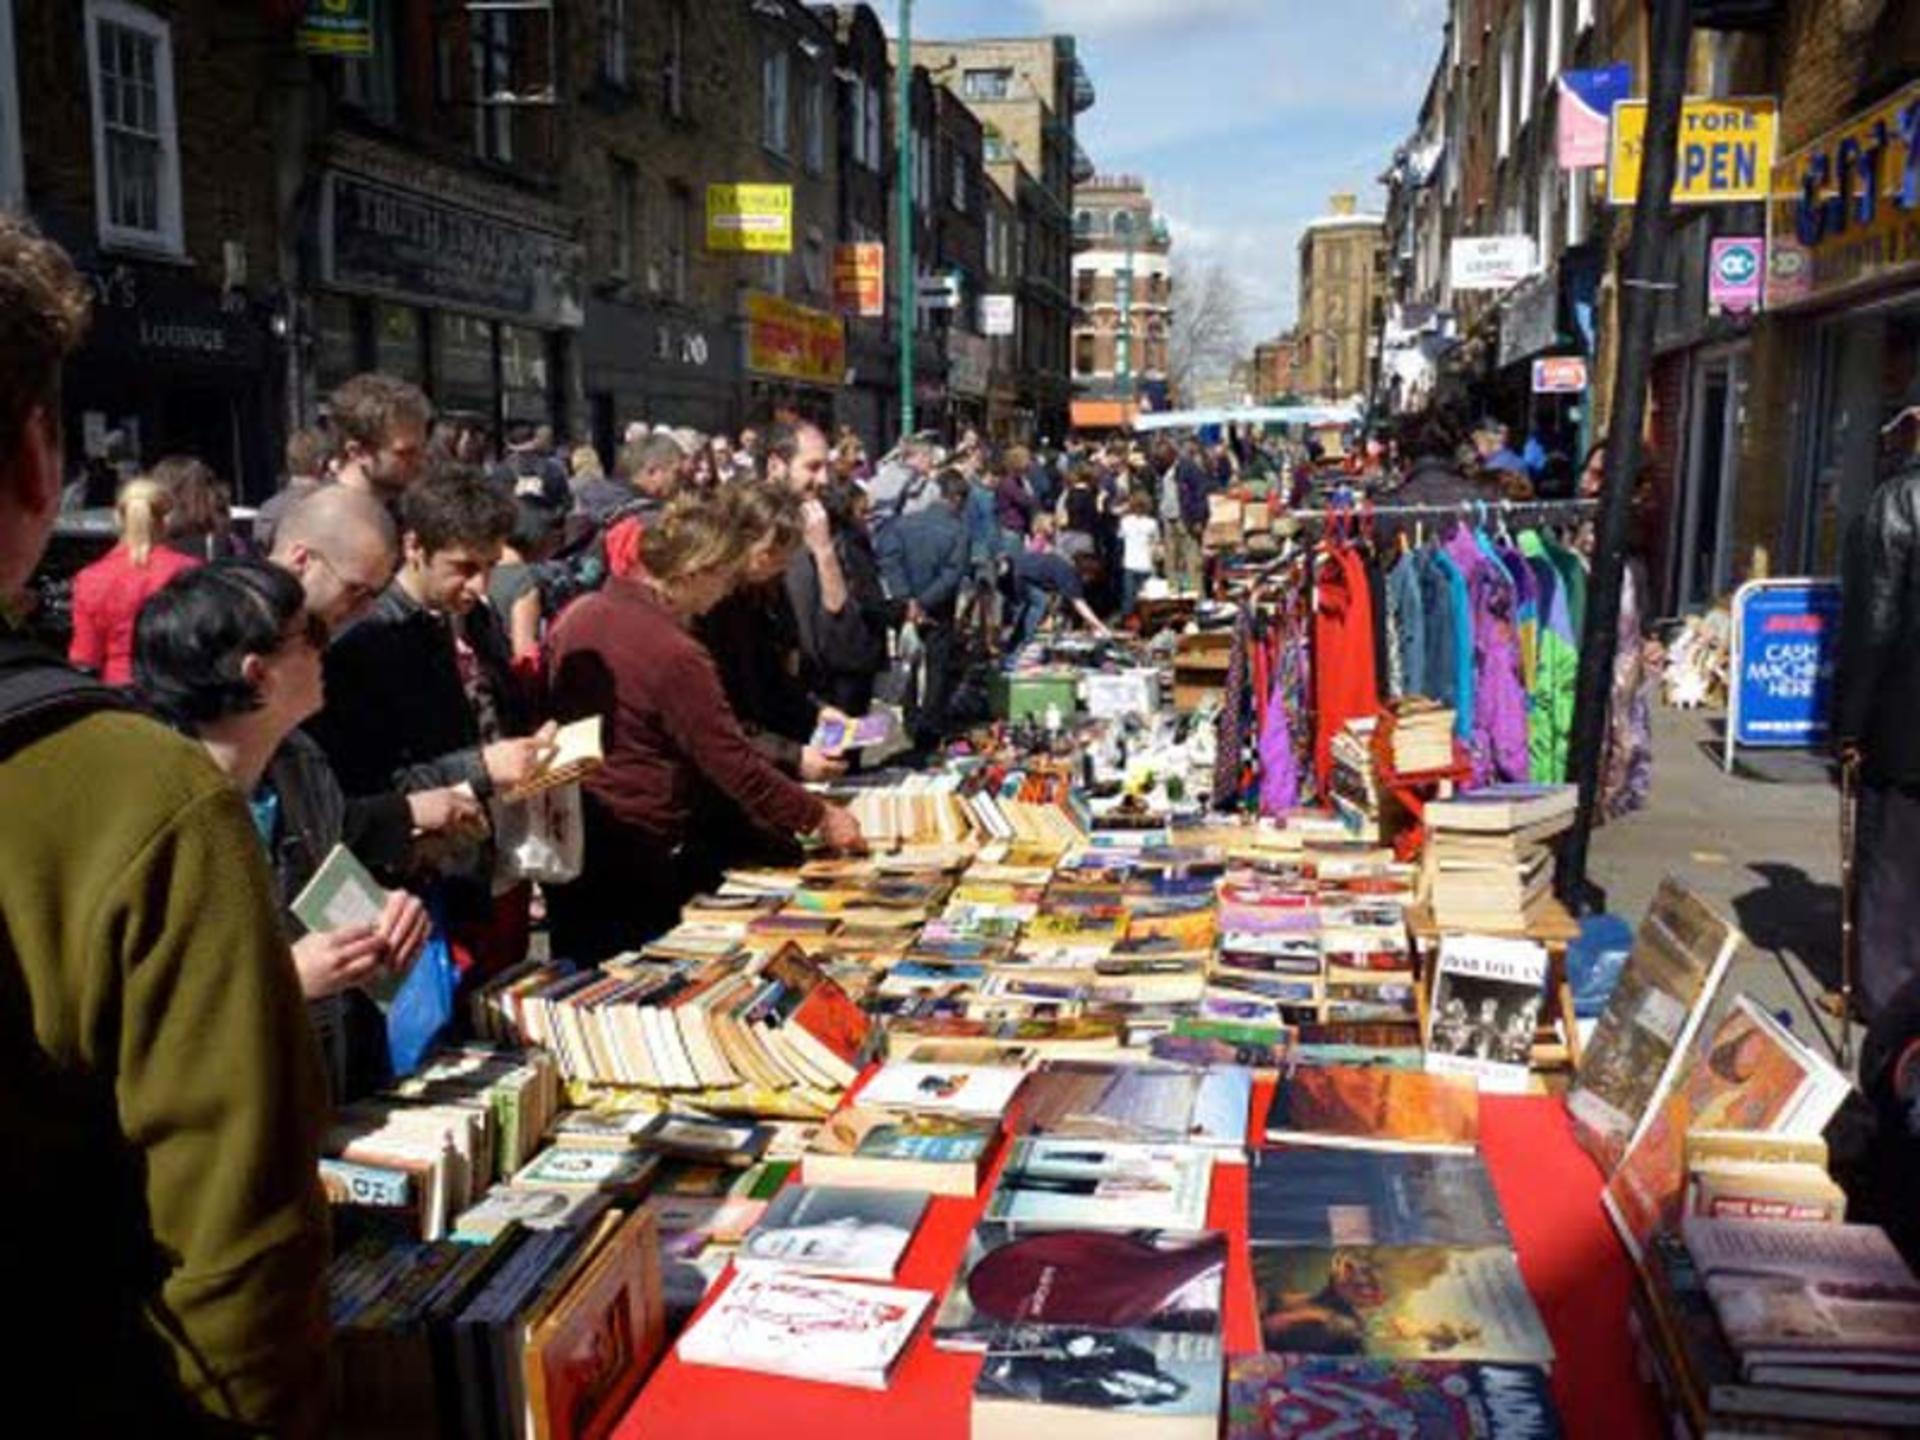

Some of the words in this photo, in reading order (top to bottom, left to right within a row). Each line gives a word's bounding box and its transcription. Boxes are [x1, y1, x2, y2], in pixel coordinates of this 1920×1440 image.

[1685, 112, 1757, 131] TORE
[1683, 141, 1757, 190] PEN
[1765, 643, 1818, 662] CASH
